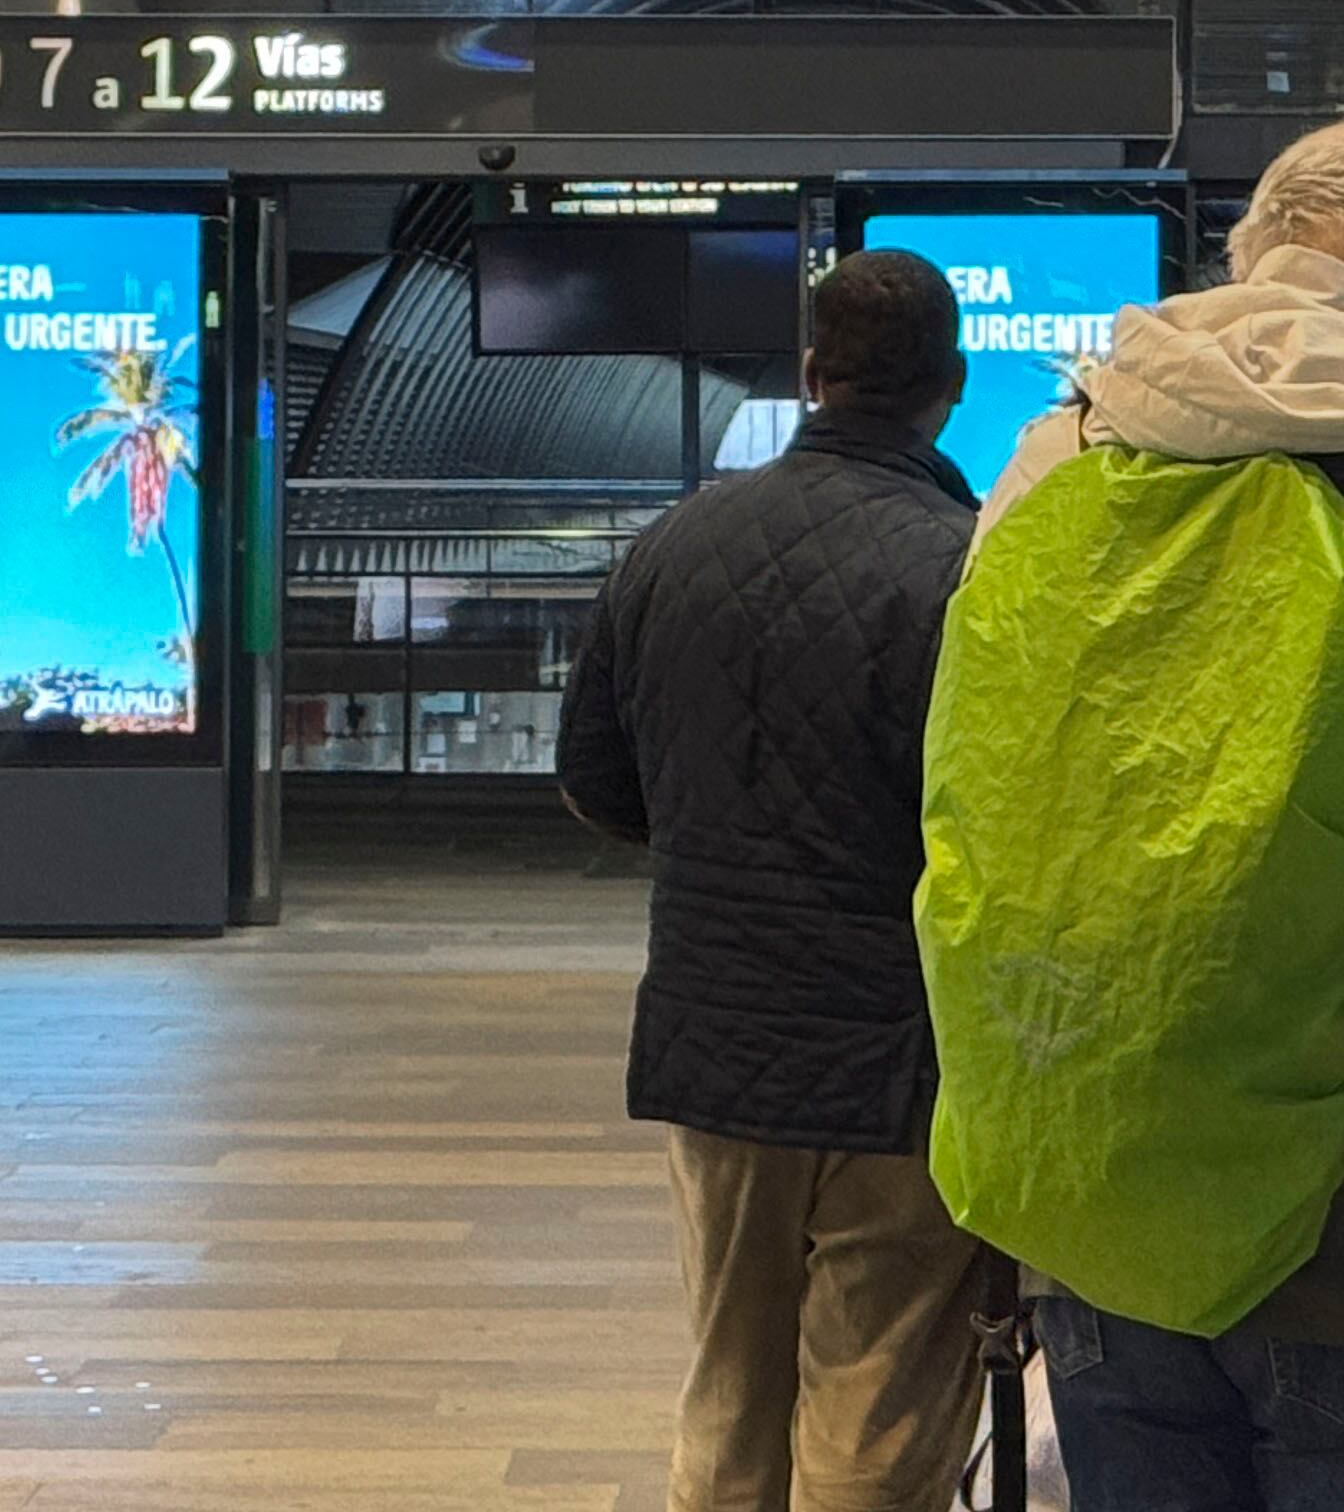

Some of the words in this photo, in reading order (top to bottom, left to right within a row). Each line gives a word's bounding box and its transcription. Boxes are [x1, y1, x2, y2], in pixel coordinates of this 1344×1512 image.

[30, 37, 72, 108] 7
[93, 77, 119, 109] a
[141, 36, 235, 110] 12
[254, 32, 345, 78] Vías
[254, 88, 383, 113] PLATFORMS
[946, 265, 1013, 305] ERA
[4, 312, 167, 351] URGENTE.
[964, 312, 1114, 352] URGENTE
